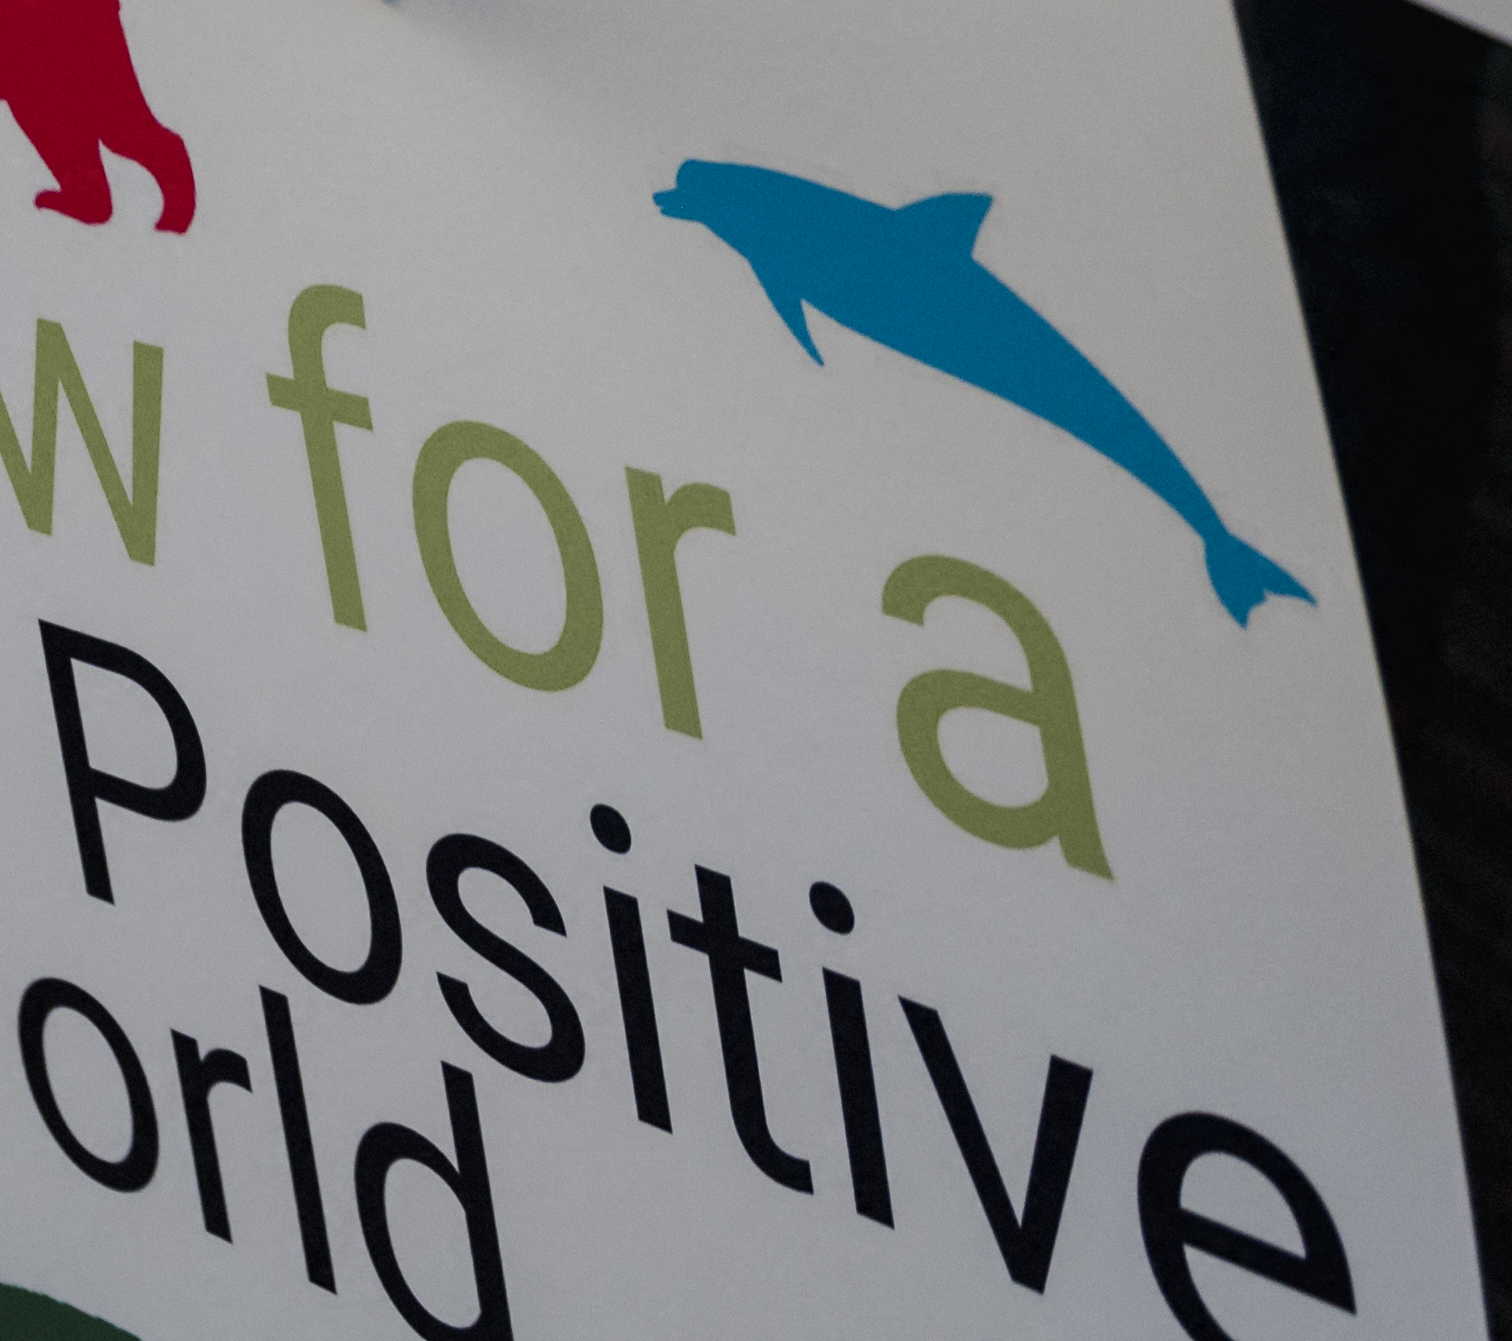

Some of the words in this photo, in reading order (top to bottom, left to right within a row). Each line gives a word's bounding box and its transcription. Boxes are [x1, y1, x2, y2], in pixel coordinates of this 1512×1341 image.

[265, 285, 736, 744] for
[880, 553, 1117, 882] a
[35, 618, 1358, 1341] Positive
